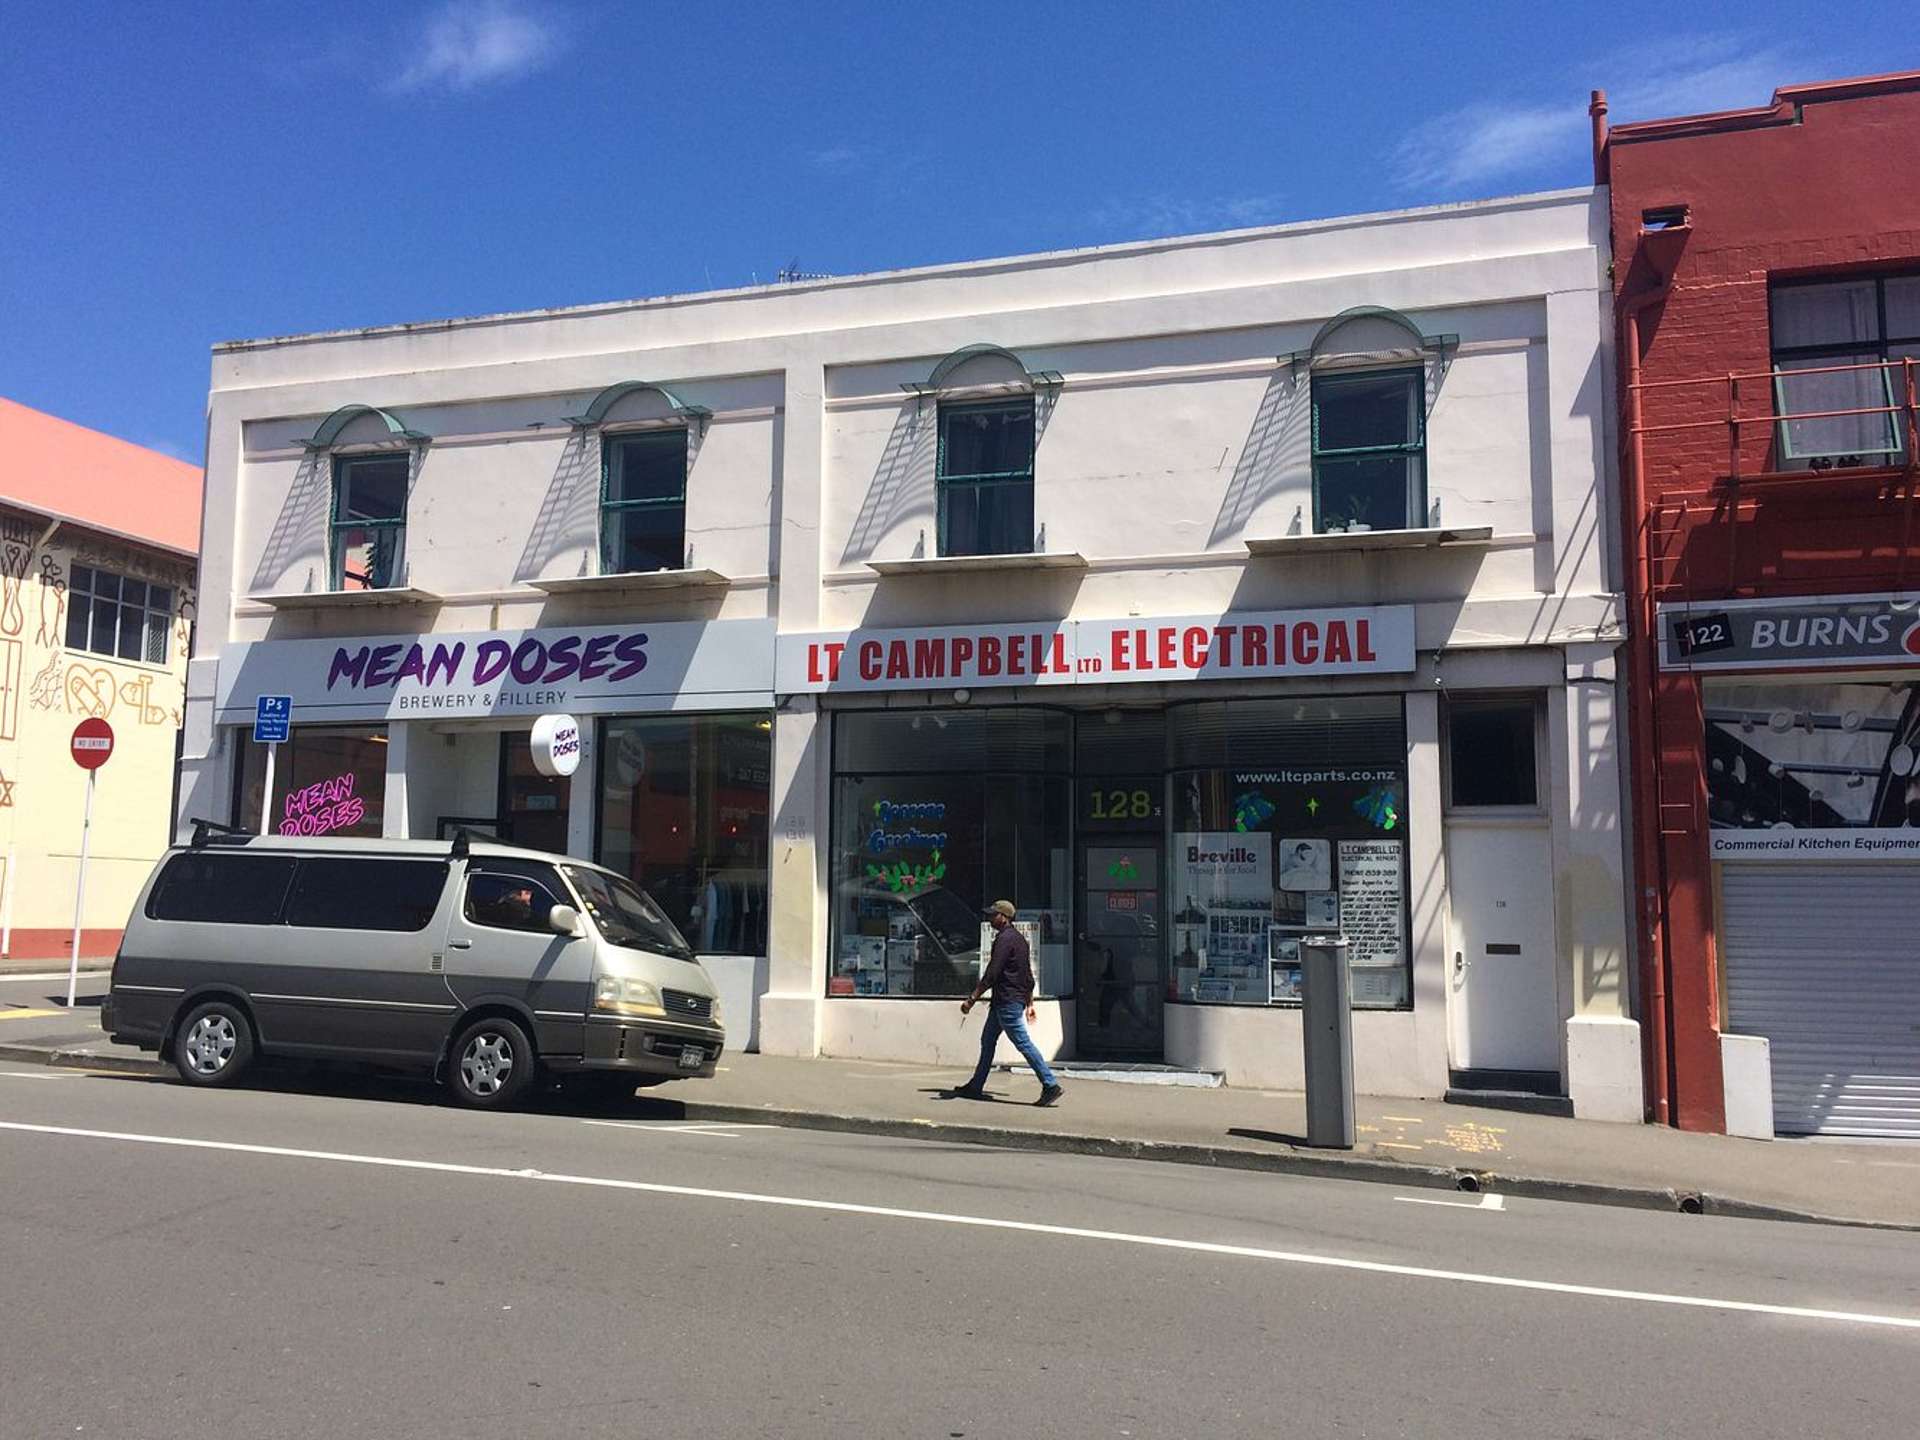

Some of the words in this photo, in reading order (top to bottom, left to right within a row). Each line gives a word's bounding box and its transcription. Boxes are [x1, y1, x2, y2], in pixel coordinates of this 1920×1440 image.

[1685, 624, 1725, 647] 122
[1751, 614, 1892, 649] BURNS
[327, 641, 466, 691] MEAN
[473, 633, 649, 687] DOSES
[808, 643, 845, 683] LT
[859, 633, 1070, 681] CAMPBELL
[1077, 658, 1102, 673] LTD
[1111, 619, 1376, 671] ELECTRICAL
[399, 694, 476, 709] BREWERY
[483, 693, 492, 706] &
[500, 690, 567, 706] FILLERY
[555, 728, 577, 743] MEAN
[553, 740, 579, 757] DOSES
[1236, 769, 1396, 784] www.ltcparts.co.nz
[286, 772, 354, 817] MEAN
[1090, 790, 1151, 818] 128
[279, 797, 364, 836] DOSES
[1187, 846, 1257, 863] Breville
[1714, 838, 1795, 850] Commercial
[1799, 837, 1850, 849] Kitchen
